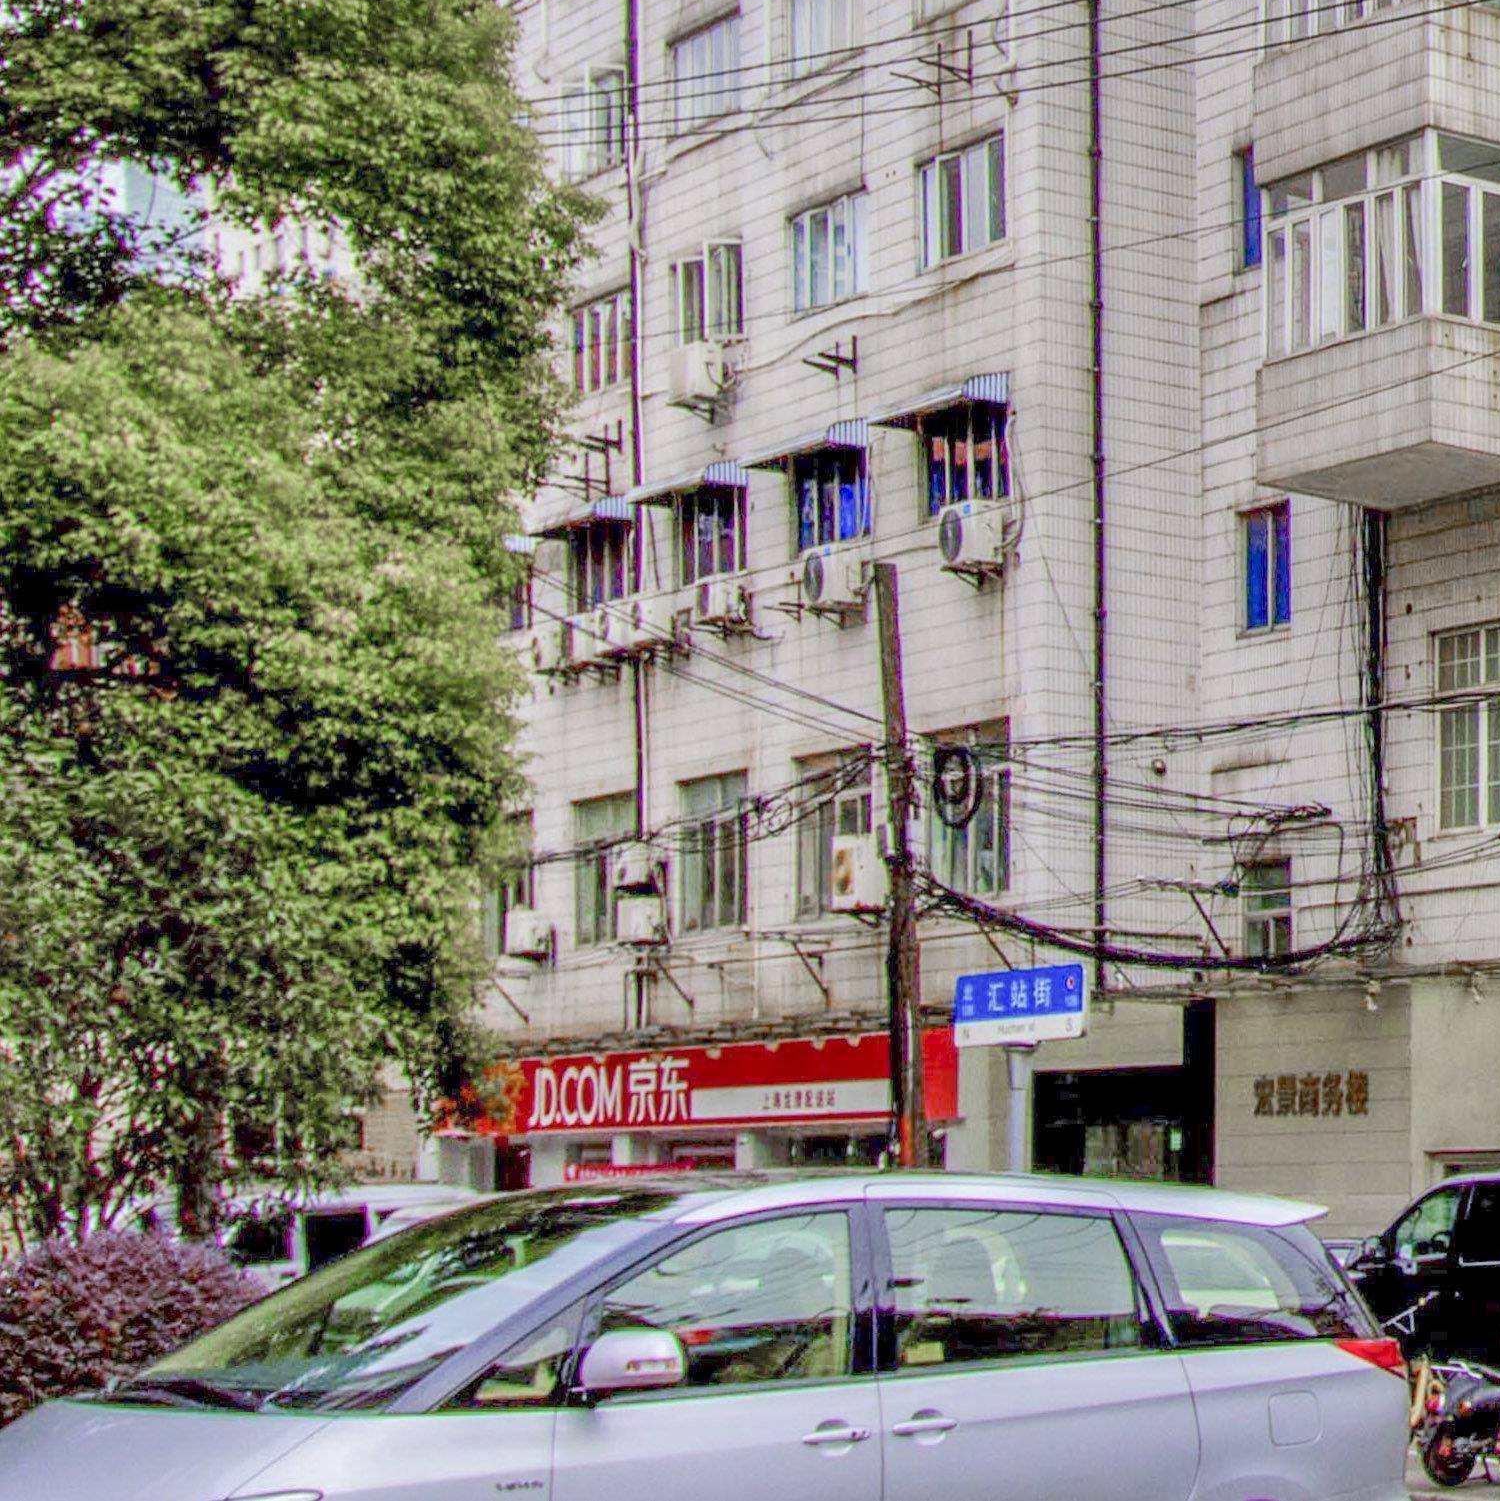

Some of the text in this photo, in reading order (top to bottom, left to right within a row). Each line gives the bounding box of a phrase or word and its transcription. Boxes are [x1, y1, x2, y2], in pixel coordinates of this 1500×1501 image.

[988, 977, 1052, 1012] 汇站街
[528, 1056, 691, 1127] JD.COM 京东
[1253, 1068, 1370, 1117] 宏景商务楼
